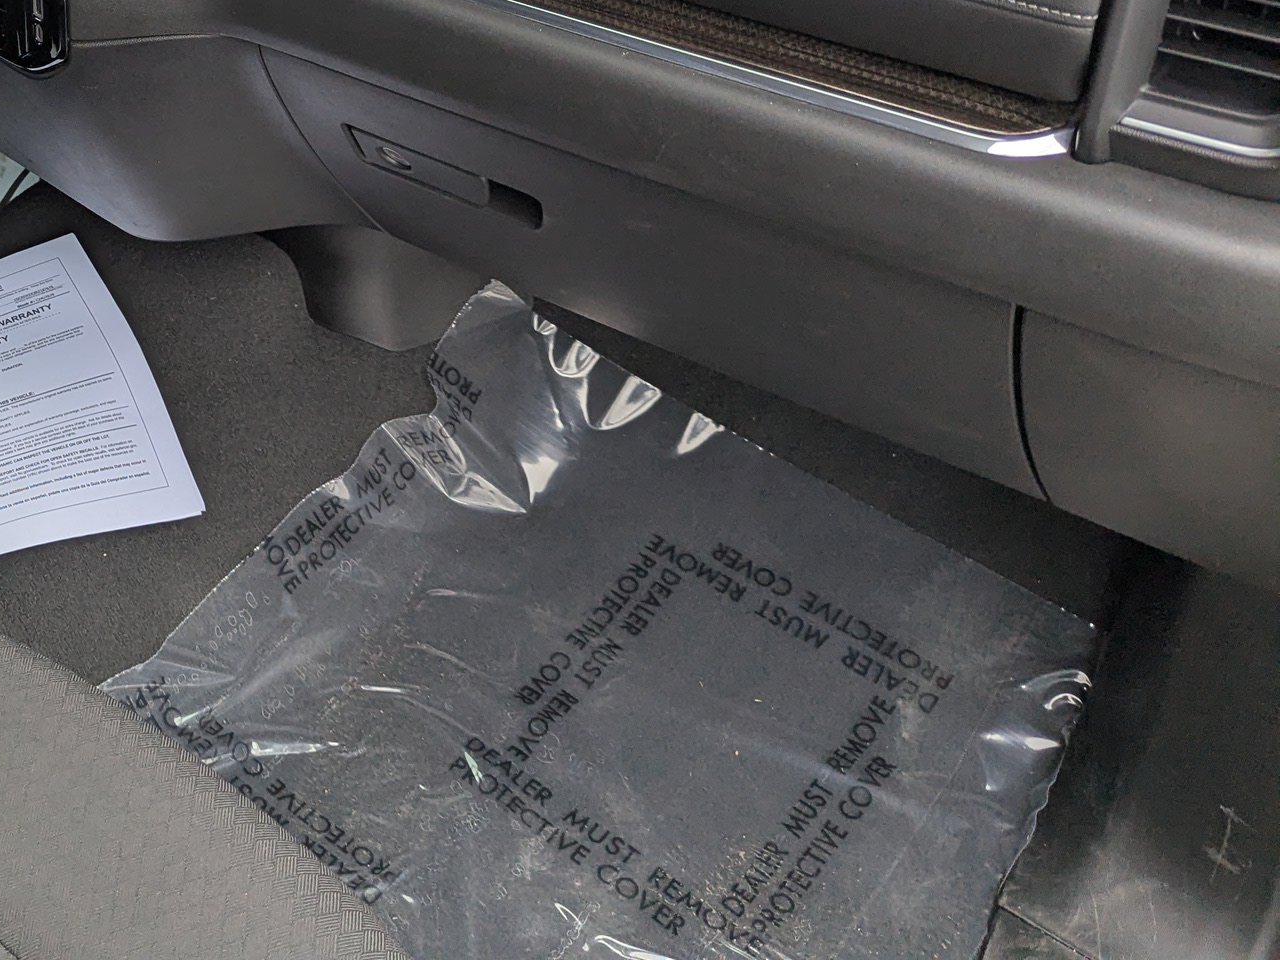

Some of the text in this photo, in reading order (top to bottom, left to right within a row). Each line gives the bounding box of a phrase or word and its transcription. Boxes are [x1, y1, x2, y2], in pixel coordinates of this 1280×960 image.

[9, 391, 35, 401] VEHICLE:
[284, 496, 345, 557] DEALER
[356, 448, 392, 498] MUST
[298, 486, 397, 581] PROTECTIVE
[507, 567, 682, 763] DEALER MUST REMOVE
[514, 551, 657, 706] PROTECTIVE COVER
[644, 532, 941, 715] DEALER MUST REMOVE
[712, 542, 956, 692] PROTECTIVE COVER
[198, 707, 403, 879] PROTECTIVE COVER
[464, 737, 554, 807] DEALER
[562, 808, 642, 864] MUST
[781, 778, 834, 840] MUST
[825, 695, 897, 776] REMOVE
[449, 756, 686, 937] PROTECTIVE COVER
[751, 755, 899, 934] PROTECTIVE COVER
